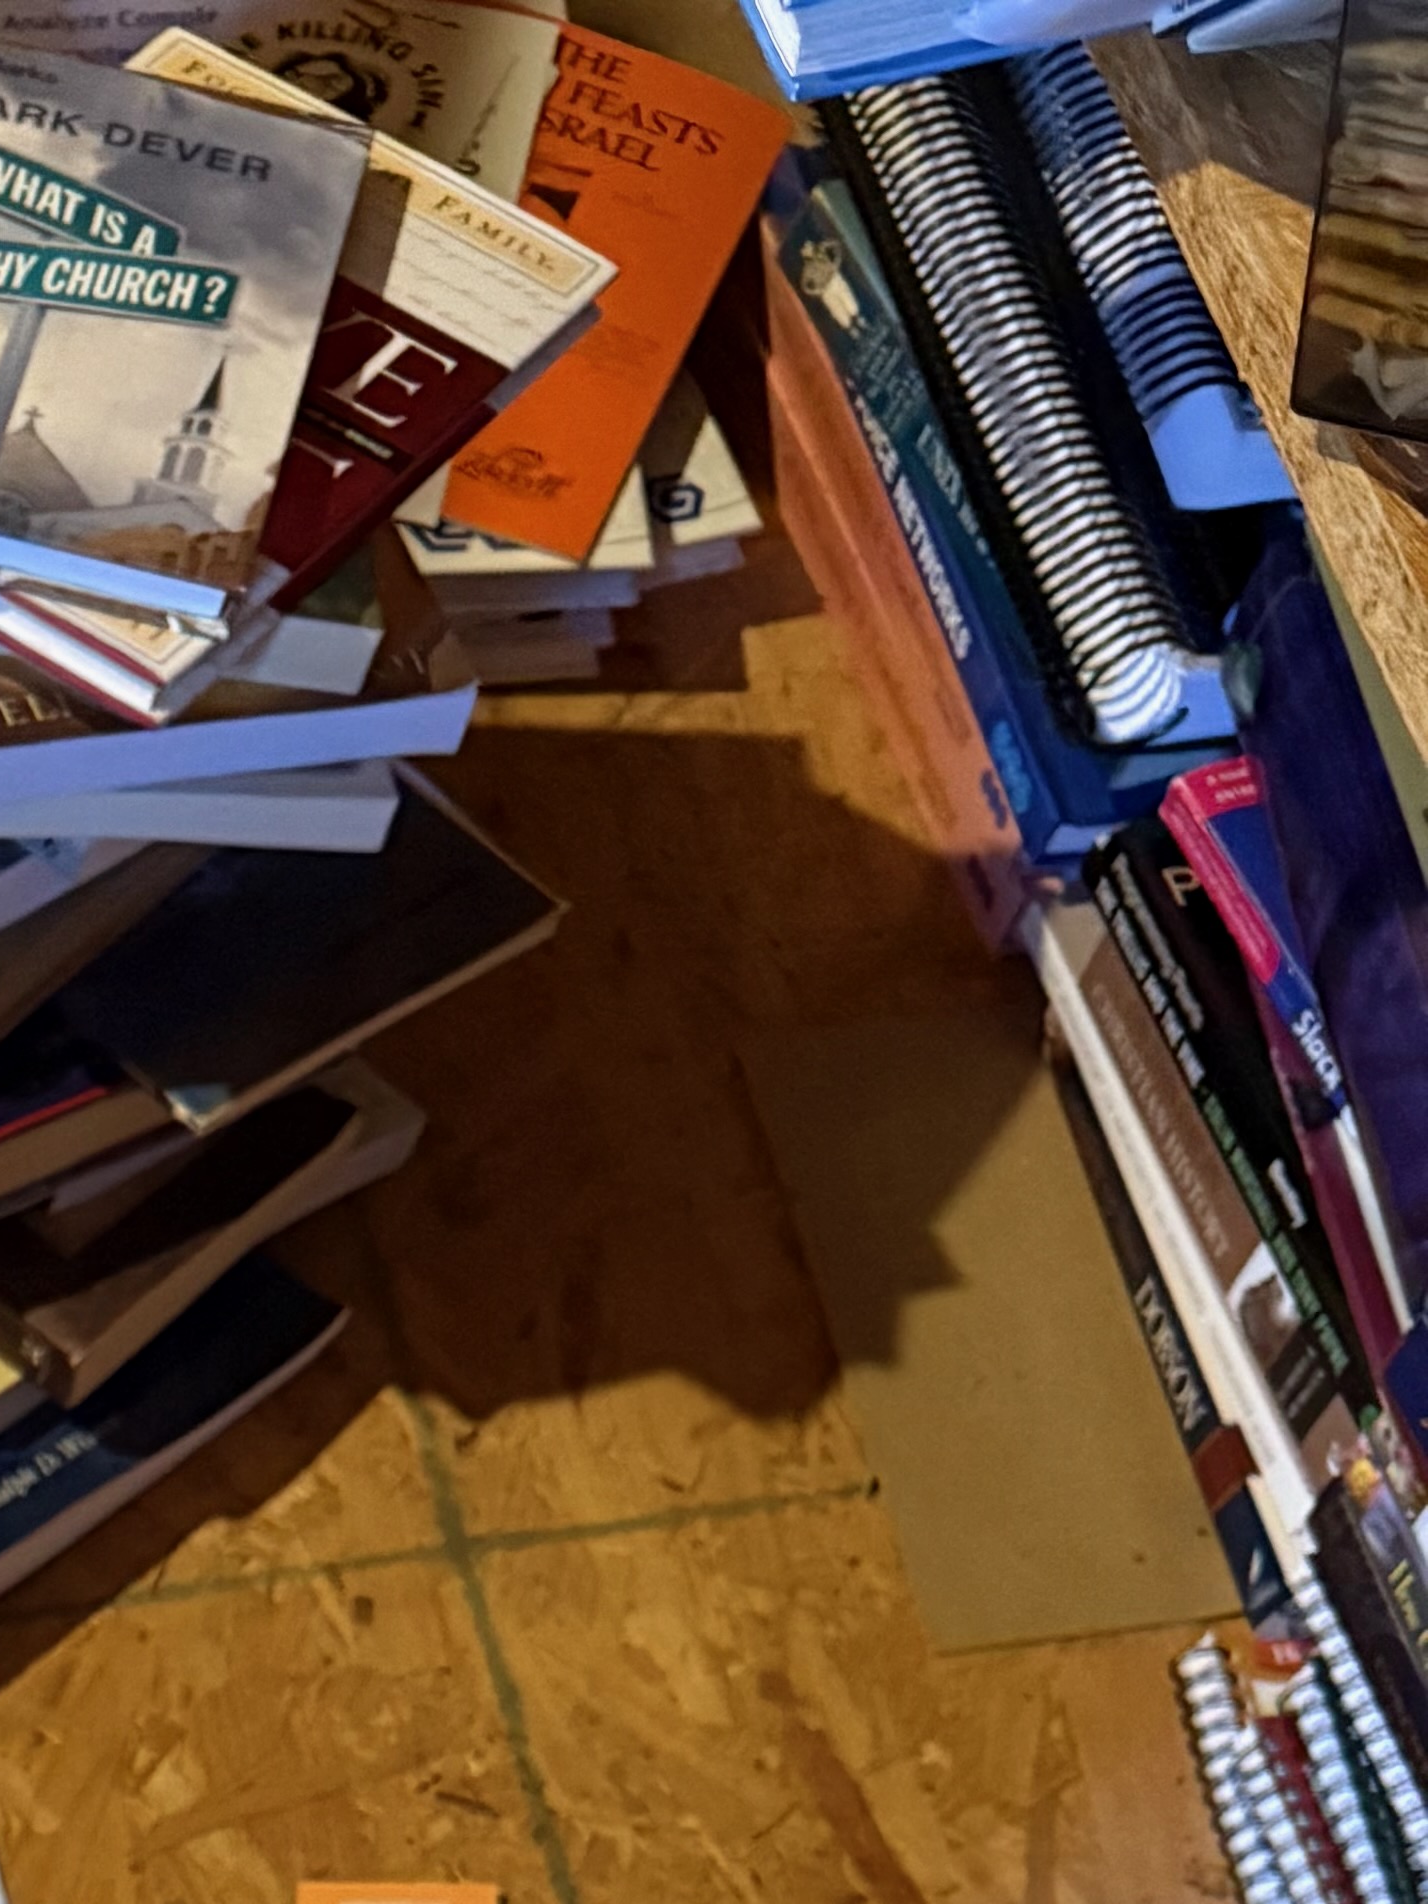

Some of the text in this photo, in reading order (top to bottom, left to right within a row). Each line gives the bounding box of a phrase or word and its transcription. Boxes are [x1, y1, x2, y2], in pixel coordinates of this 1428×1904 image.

[277, 20, 414, 63] KILLING
[101, 120, 274, 184] DEVER
[569, 80, 728, 156] FEASTS
[89, 205, 127, 246] IS
[130, 224, 158, 258] A
[896, 502, 971, 662] NETWORKS
[1087, 980, 1174, 1135] CHRISTIAN
[1162, 1131, 1232, 1260] HISTORY
